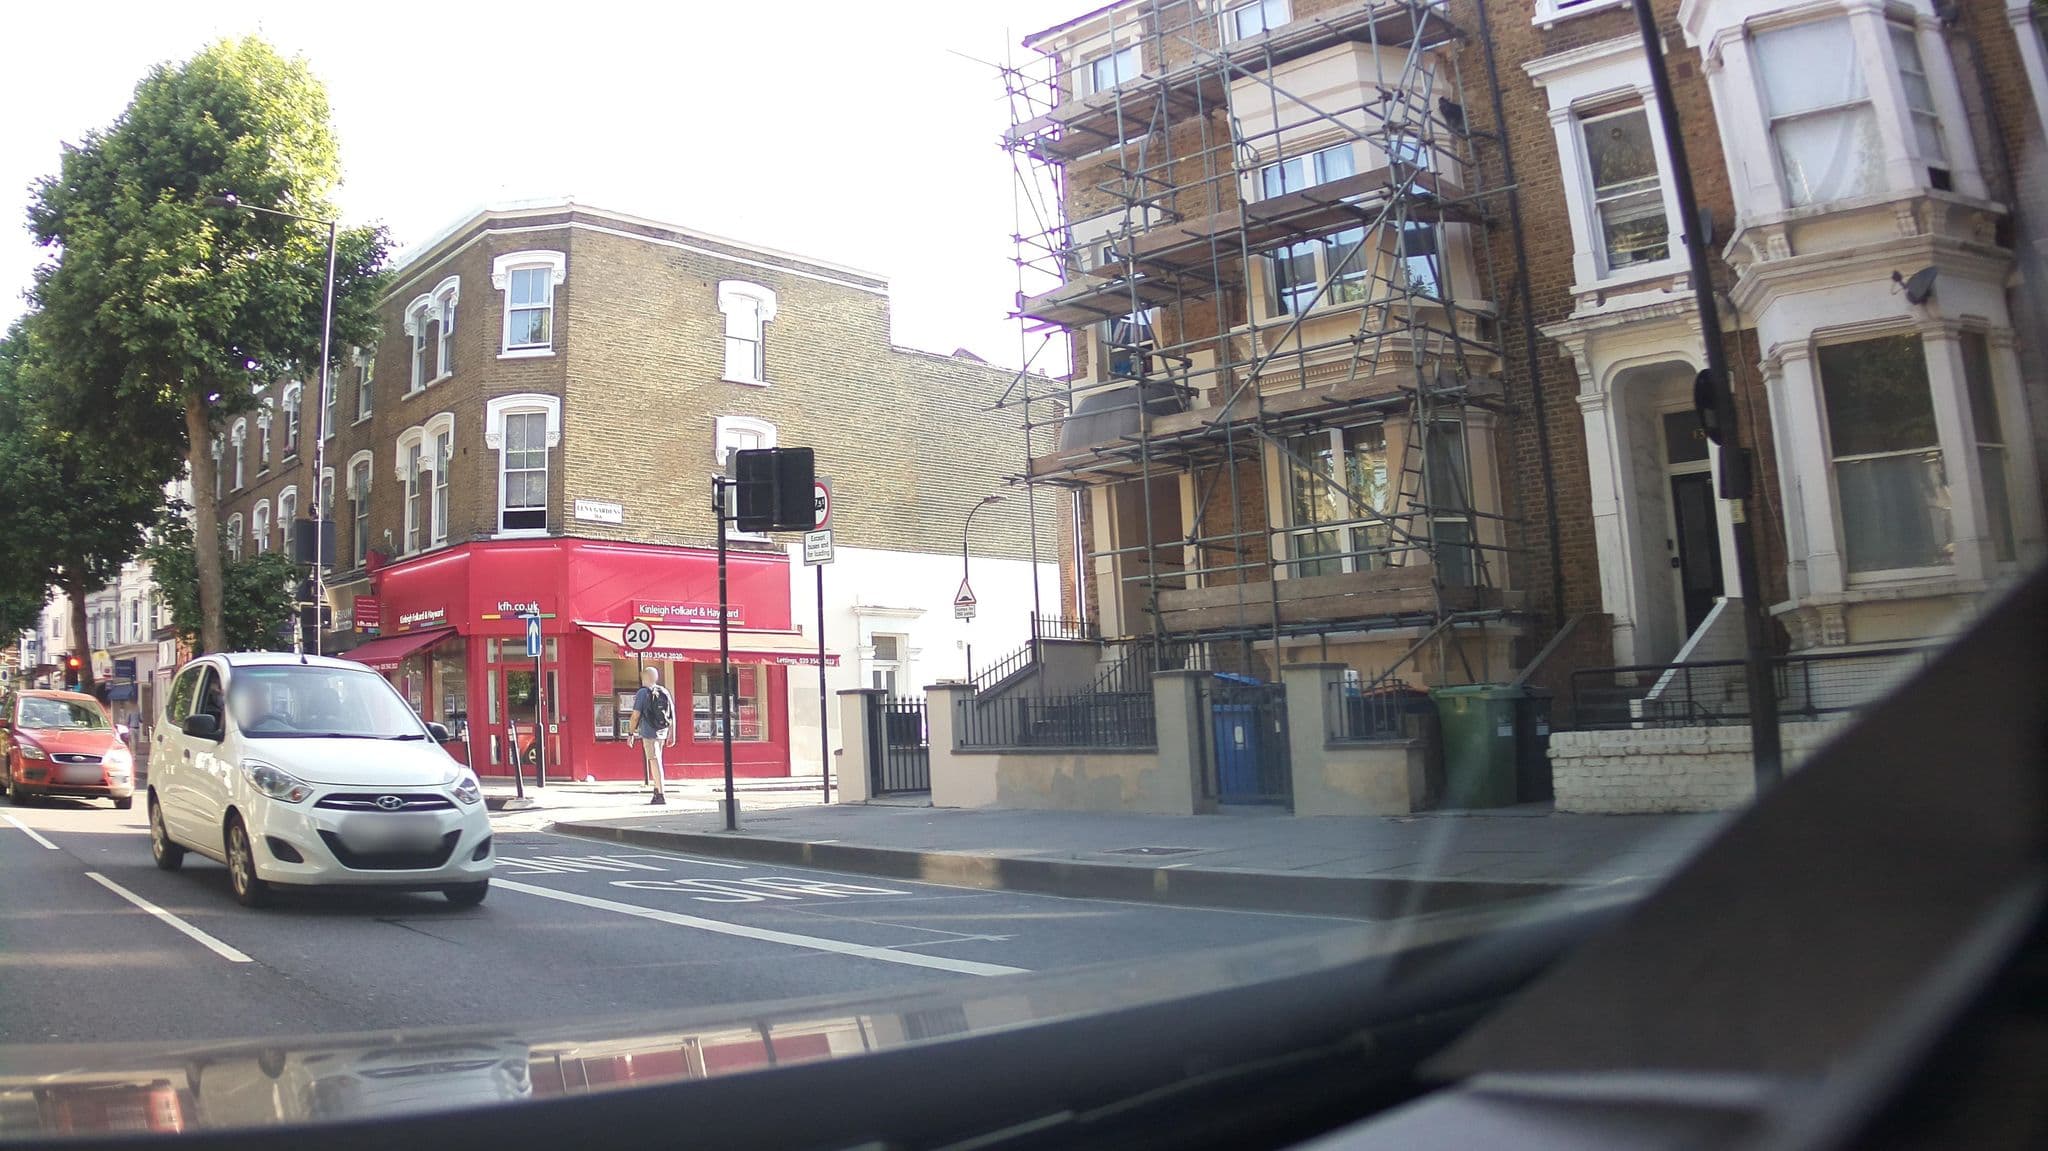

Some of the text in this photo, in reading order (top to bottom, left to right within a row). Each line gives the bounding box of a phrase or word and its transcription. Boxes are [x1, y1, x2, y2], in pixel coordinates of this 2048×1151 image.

[814, 549, 830, 558] loading
[497, 600, 539, 612] kfh.co.uk
[639, 604, 739, 619] Kinleigh Folkard & Hayard
[627, 629, 650, 643] 20
[607, 877, 913, 902] BUS
